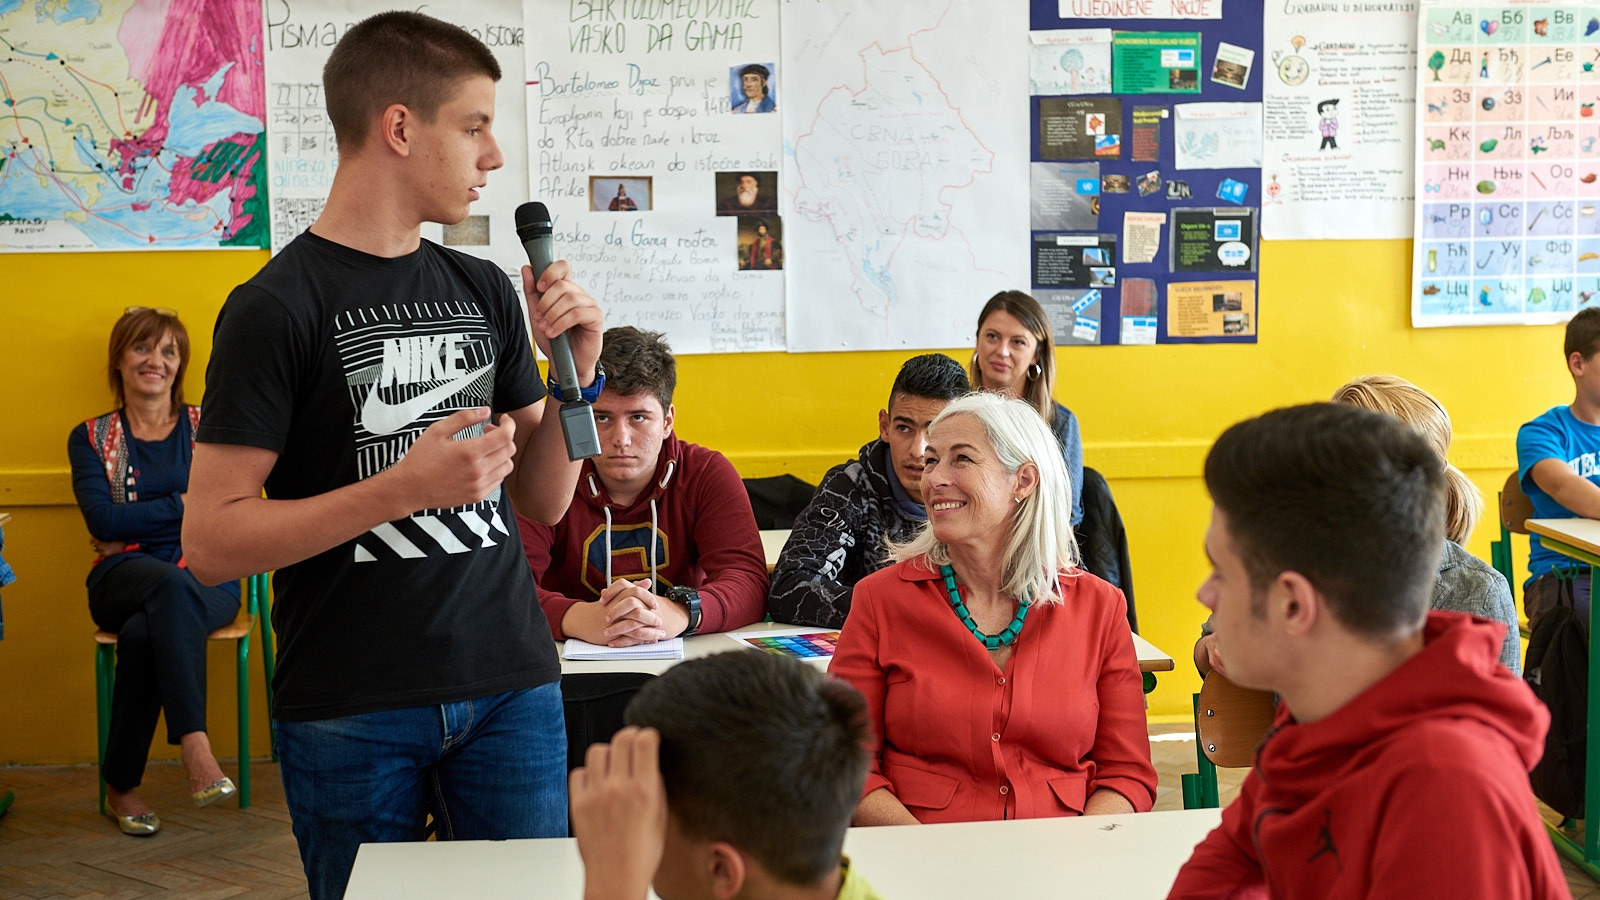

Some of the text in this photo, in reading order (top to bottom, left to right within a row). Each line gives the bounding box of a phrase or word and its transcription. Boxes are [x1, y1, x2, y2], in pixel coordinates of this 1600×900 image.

[568, 19, 743, 54] VASKO DA GAMA
[535, 61, 619, 97] Bartolomeo
[537, 127, 555, 149] do
[667, 152, 686, 171] do
[605, 220, 623, 247] da
[380, 334, 467, 389] NIKE
